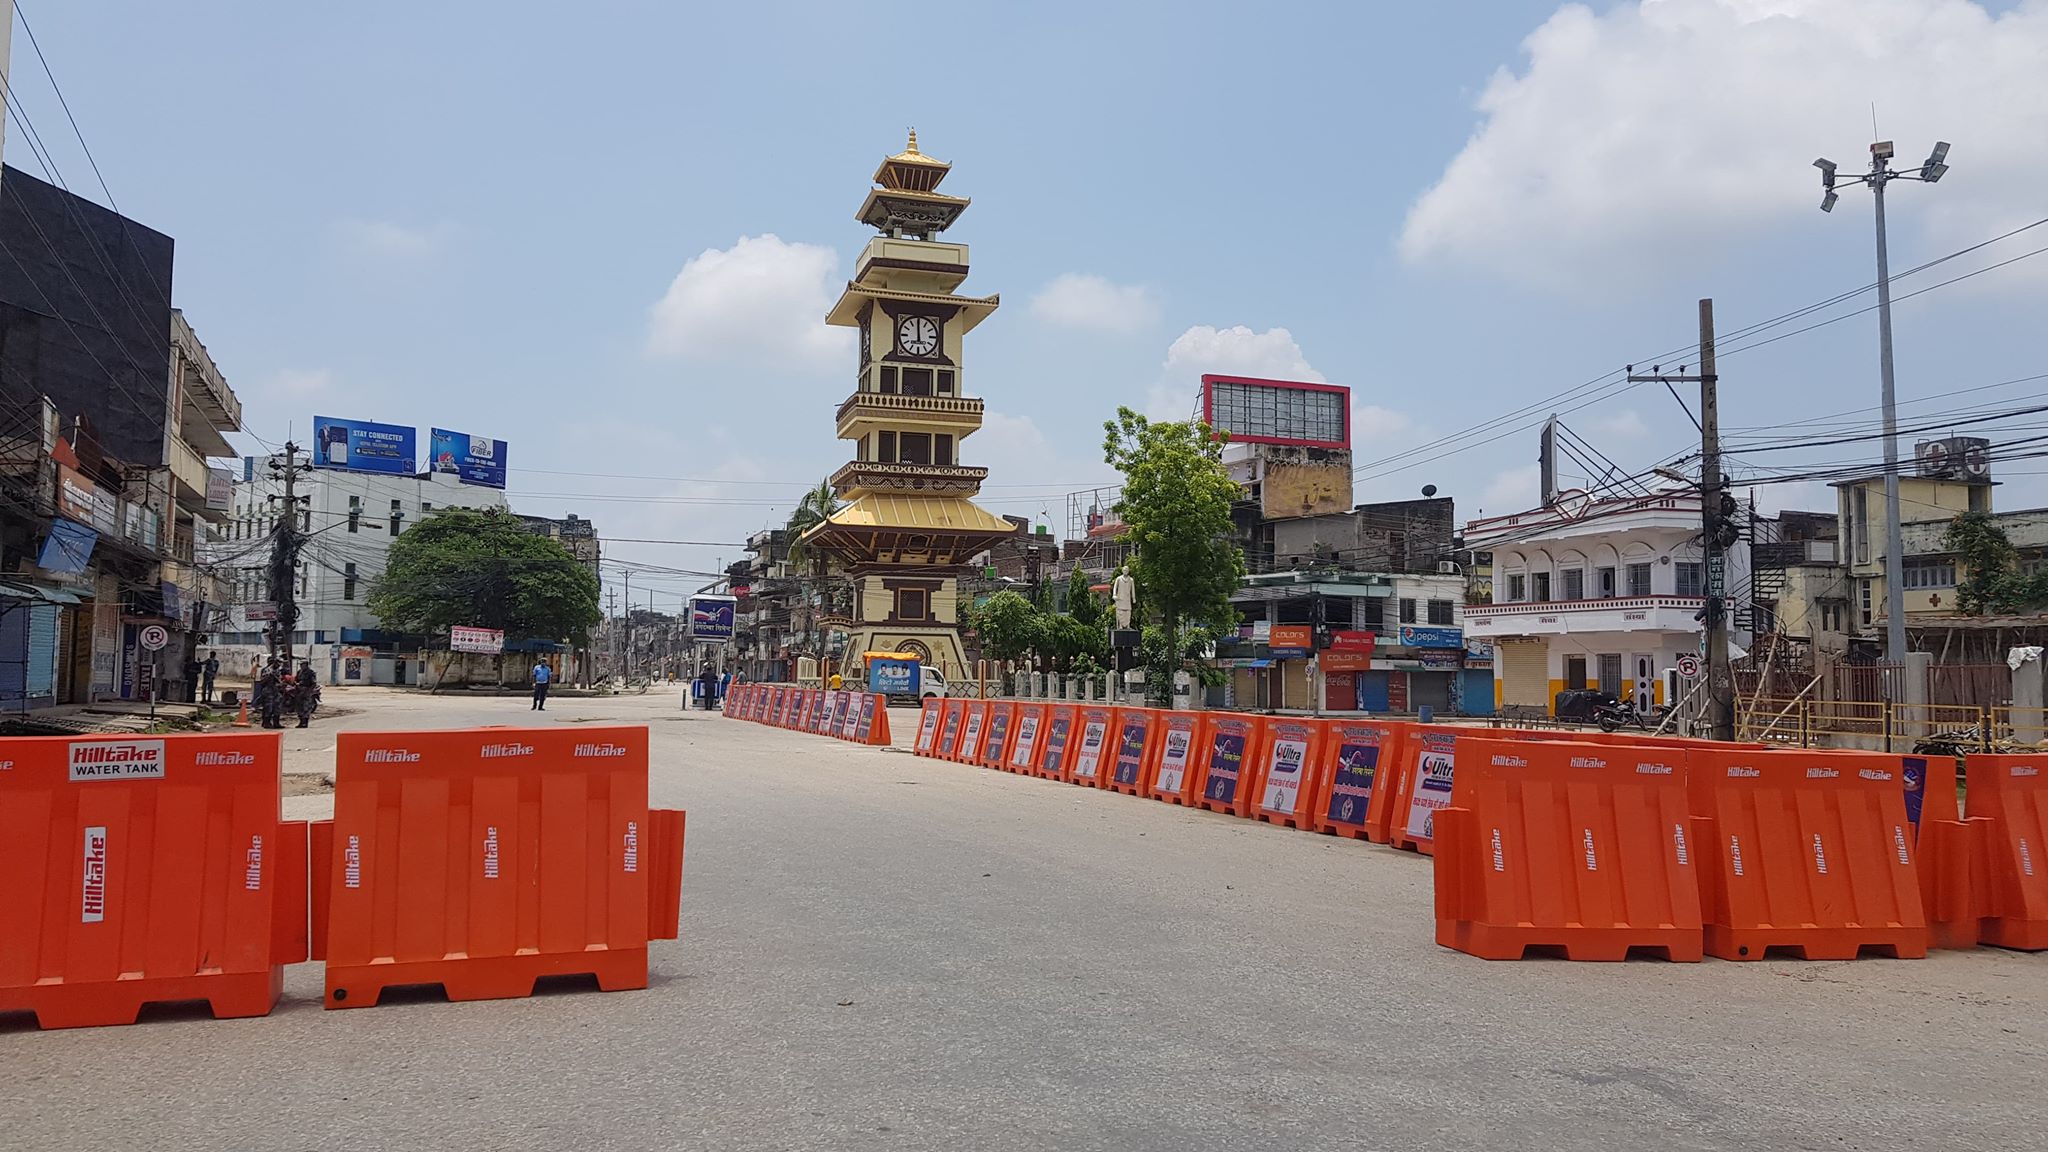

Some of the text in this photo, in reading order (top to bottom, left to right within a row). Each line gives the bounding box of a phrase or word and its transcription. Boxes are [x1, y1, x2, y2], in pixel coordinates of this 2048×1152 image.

[353, 430, 404, 442] STAY CONNECTED
[472, 447, 492, 457] FIBER
[1416, 632, 1439, 643] pepsi
[73, 746, 158, 764] Hilltake
[366, 750, 420, 763] Hilltake
[482, 744, 534, 757] Hilltake
[575, 744, 626, 757] Hilltake
[1282, 746, 1301, 761] Ultra
[196, 752, 255, 765] Hilltake
[1491, 755, 1527, 767] Hilltake
[1570, 758, 1607, 768] Hilltake
[76, 763, 158, 776] WATER TANK
[1637, 764, 1673, 775] Hilltake
[1728, 767, 1760, 777] Hilltake
[1807, 768, 1840, 778] Hilltake
[1858, 769, 1893, 781] Hilltake
[624, 822, 638, 873] Hilltake
[1491, 829, 1505, 872] Hilltake
[1583, 829, 1597, 871] Hilltake
[1674, 824, 1688, 865] Hilltake
[1895, 826, 1909, 865] Hilltake
[484, 827, 499, 879] Hilltake
[1730, 836, 1744, 876] Hilltake
[1814, 834, 1827, 874] Hilltake
[246, 835, 262, 890] Hilltake
[346, 836, 360, 888] Hilltake
[85, 837, 104, 914] Hilltake
